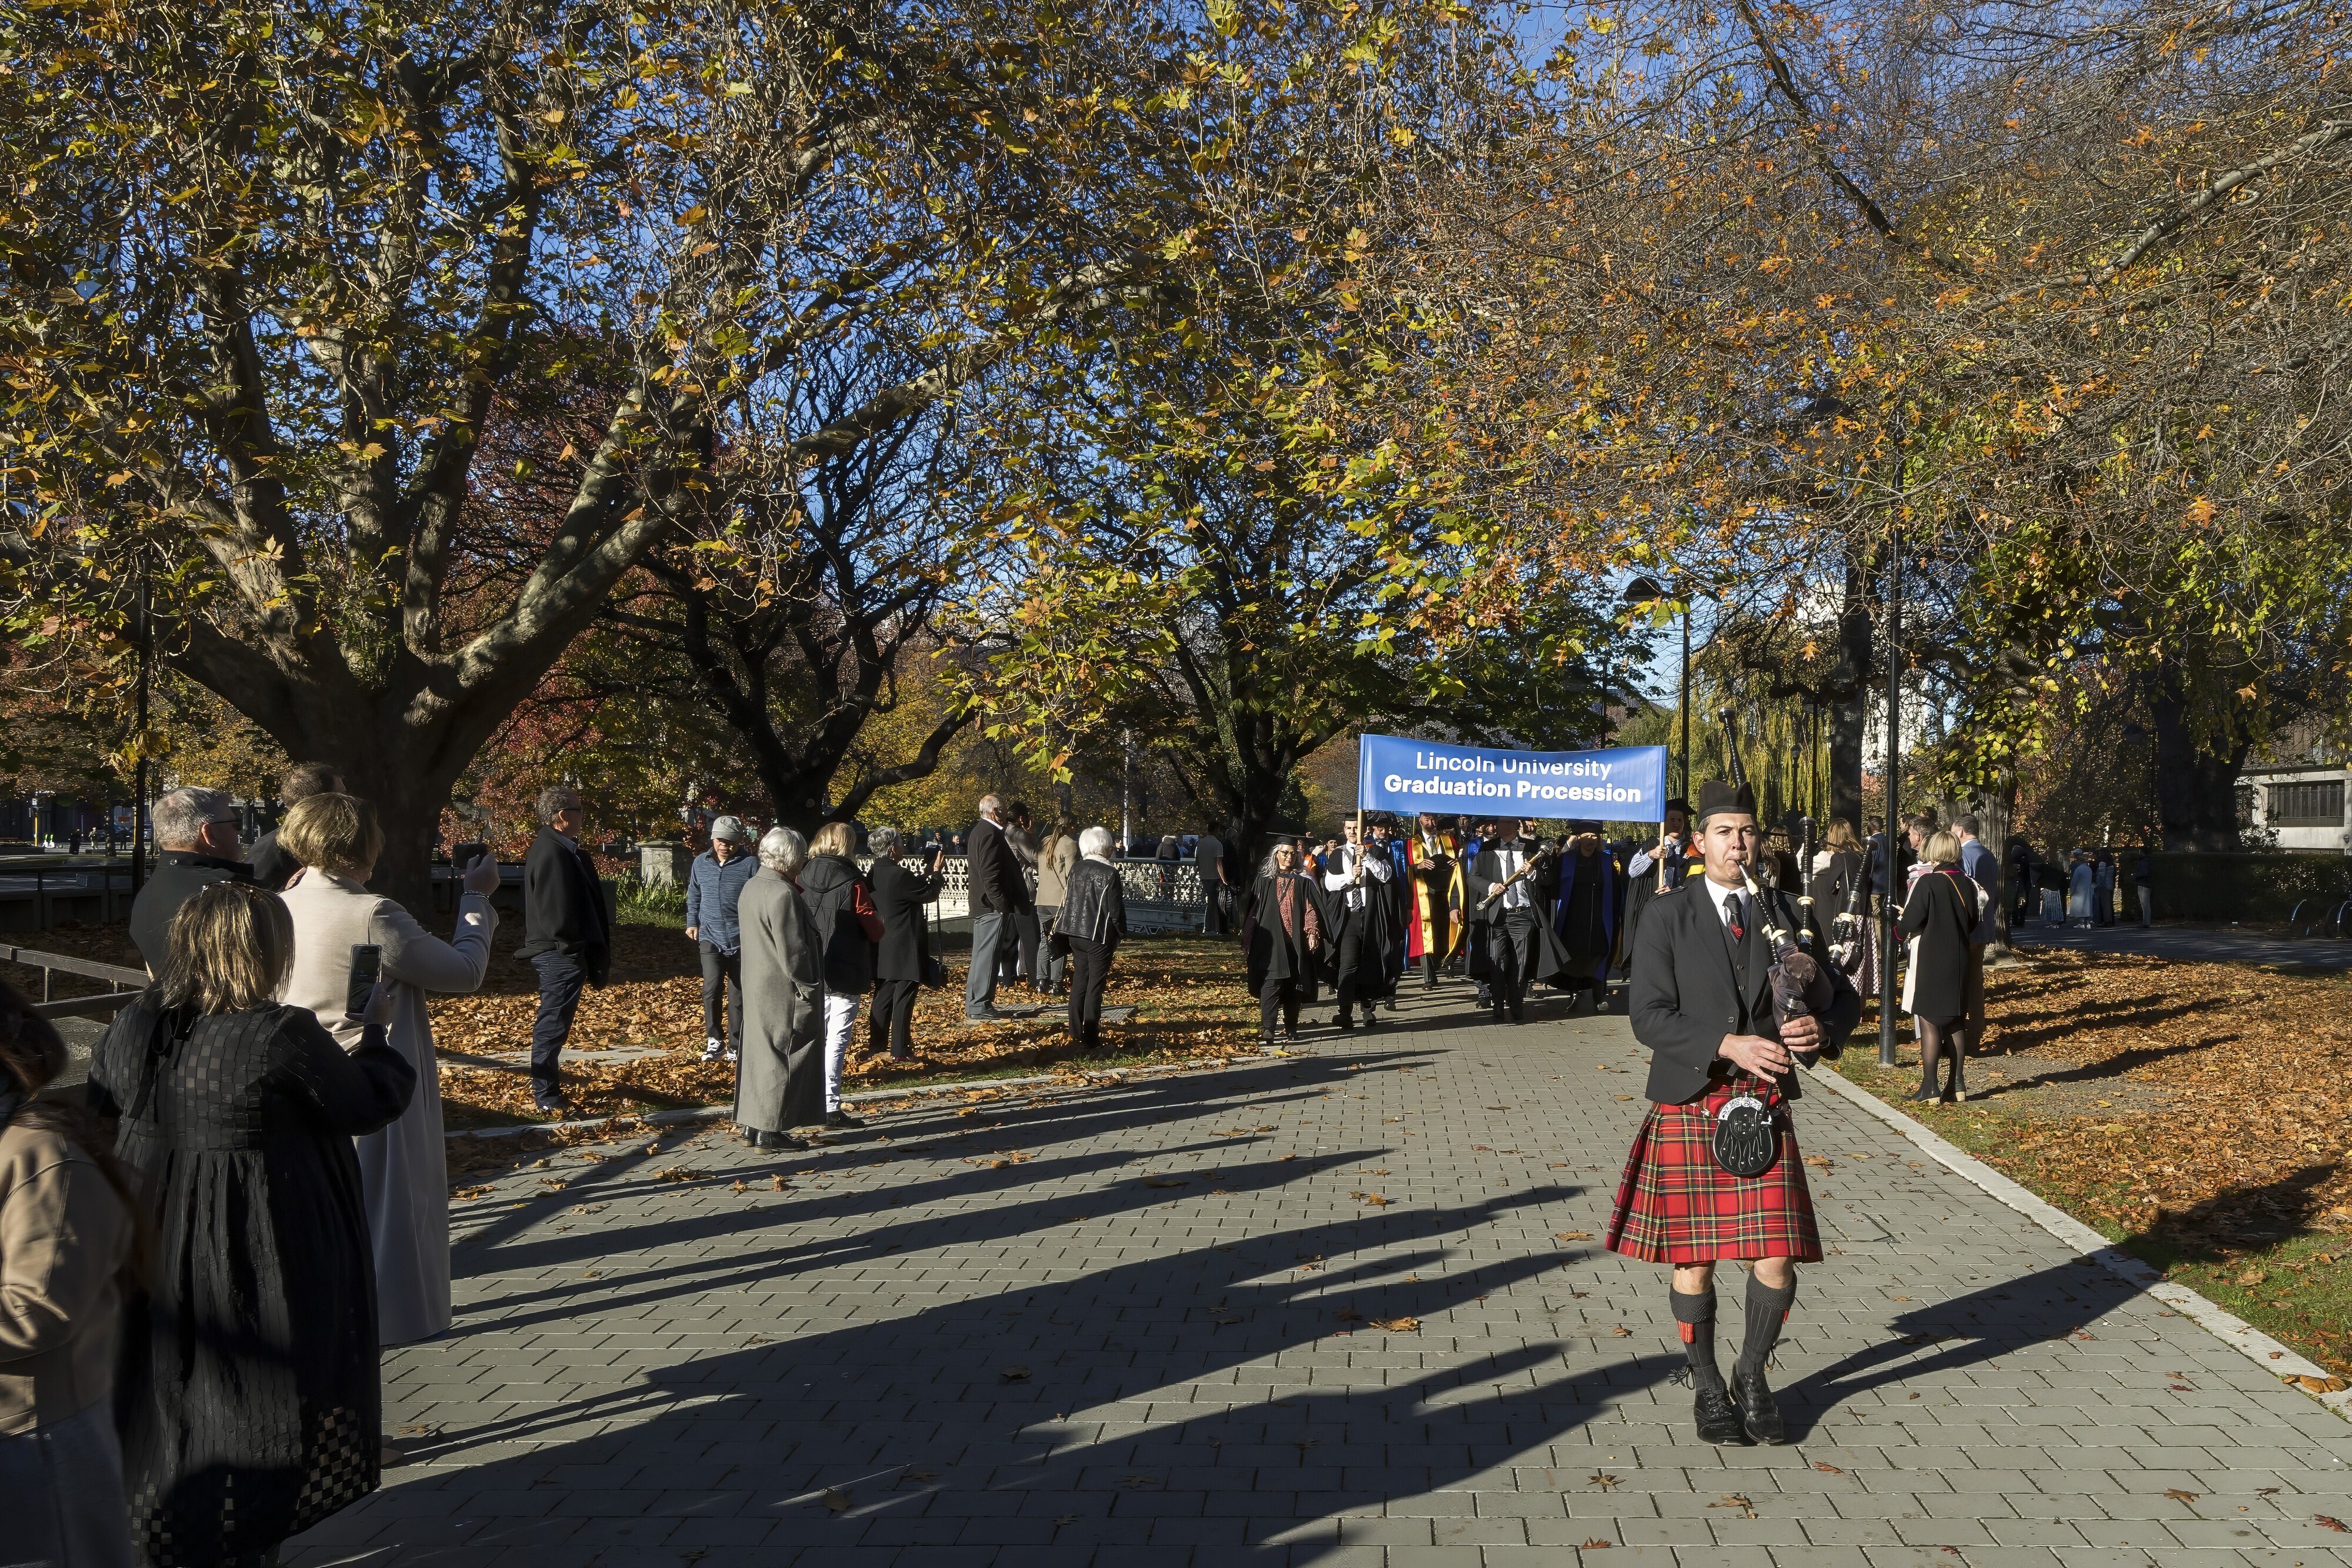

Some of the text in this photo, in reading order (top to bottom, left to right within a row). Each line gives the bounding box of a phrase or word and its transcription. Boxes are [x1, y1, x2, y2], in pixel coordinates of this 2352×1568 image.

[1416, 752, 1613, 781] Lincoln University
[1384, 774, 1641, 802] Graduation Procession
